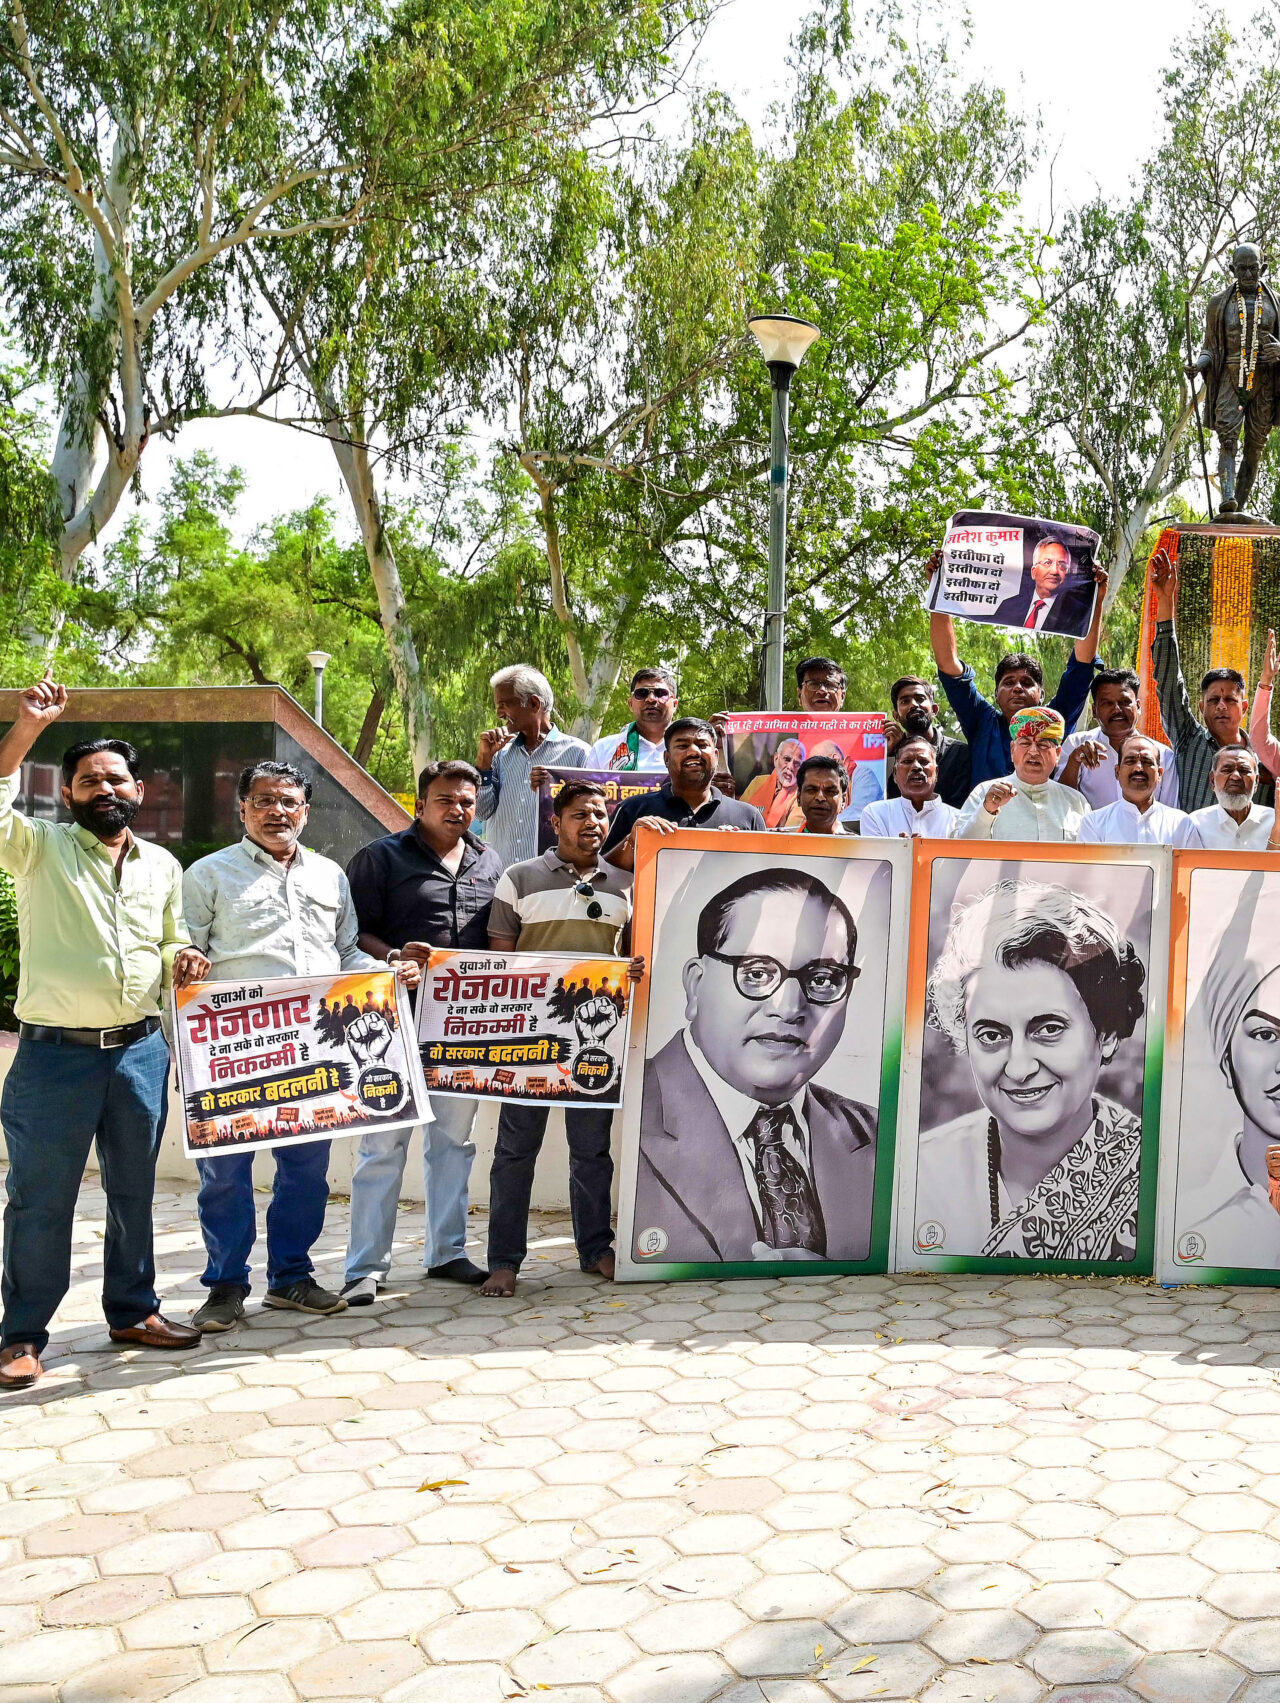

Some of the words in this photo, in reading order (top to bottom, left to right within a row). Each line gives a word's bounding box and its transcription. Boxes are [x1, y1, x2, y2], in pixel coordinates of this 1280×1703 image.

[986, 530, 1021, 546] कुमार
[951, 549, 991, 563] इस्तीफा
[993, 553, 1005, 565] दो
[948, 563, 989, 575] इस्तीफा
[991, 568, 1004, 577] दो
[946, 577, 987, 589] इस्तीफा
[988, 580, 1001, 591] दो
[943, 591, 984, 603] इस्तीफा
[986, 594, 998, 605] दो
[743, 720, 753, 731] रहे
[753, 719, 764, 731] हो
[800, 719, 818, 730] लोग
[849, 720, 861, 730] कर
[459, 959, 491, 974] युवाओं
[494, 959, 507, 971] को
[433, 968, 550, 1001] रोजगार
[211, 986, 246, 1008] युवाओं
[249, 985, 263, 999] को
[447, 1004, 454, 1015] दे
[456, 1005, 467, 1015] ना
[470, 1004, 487, 1014] सके
[489, 1003, 499, 1013] वो
[501, 1003, 533, 1013] सरकार
[187, 994, 311, 1044] रोजगार
[444, 1014, 526, 1036] निकम्मी
[529, 1015, 538, 1031] है
[209, 1044, 216, 1056] दे
[218, 1044, 231, 1055] ना
[233, 1038, 252, 1051] सके
[255, 1035, 264, 1047] वो
[266, 1030, 299, 1045] सरकार
[429, 1043, 443, 1060] वो
[445, 1047, 486, 1060] सरकार
[488, 1040, 550, 1062] बदलनी
[550, 1042, 560, 1060] है
[209, 1042, 296, 1082] निकम्मी
[299, 1043, 309, 1060] है
[200, 1092, 215, 1111] वो
[217, 1086, 262, 1107] सरकार
[264, 1067, 328, 1101] बदलनी
[329, 1068, 340, 1087] है
